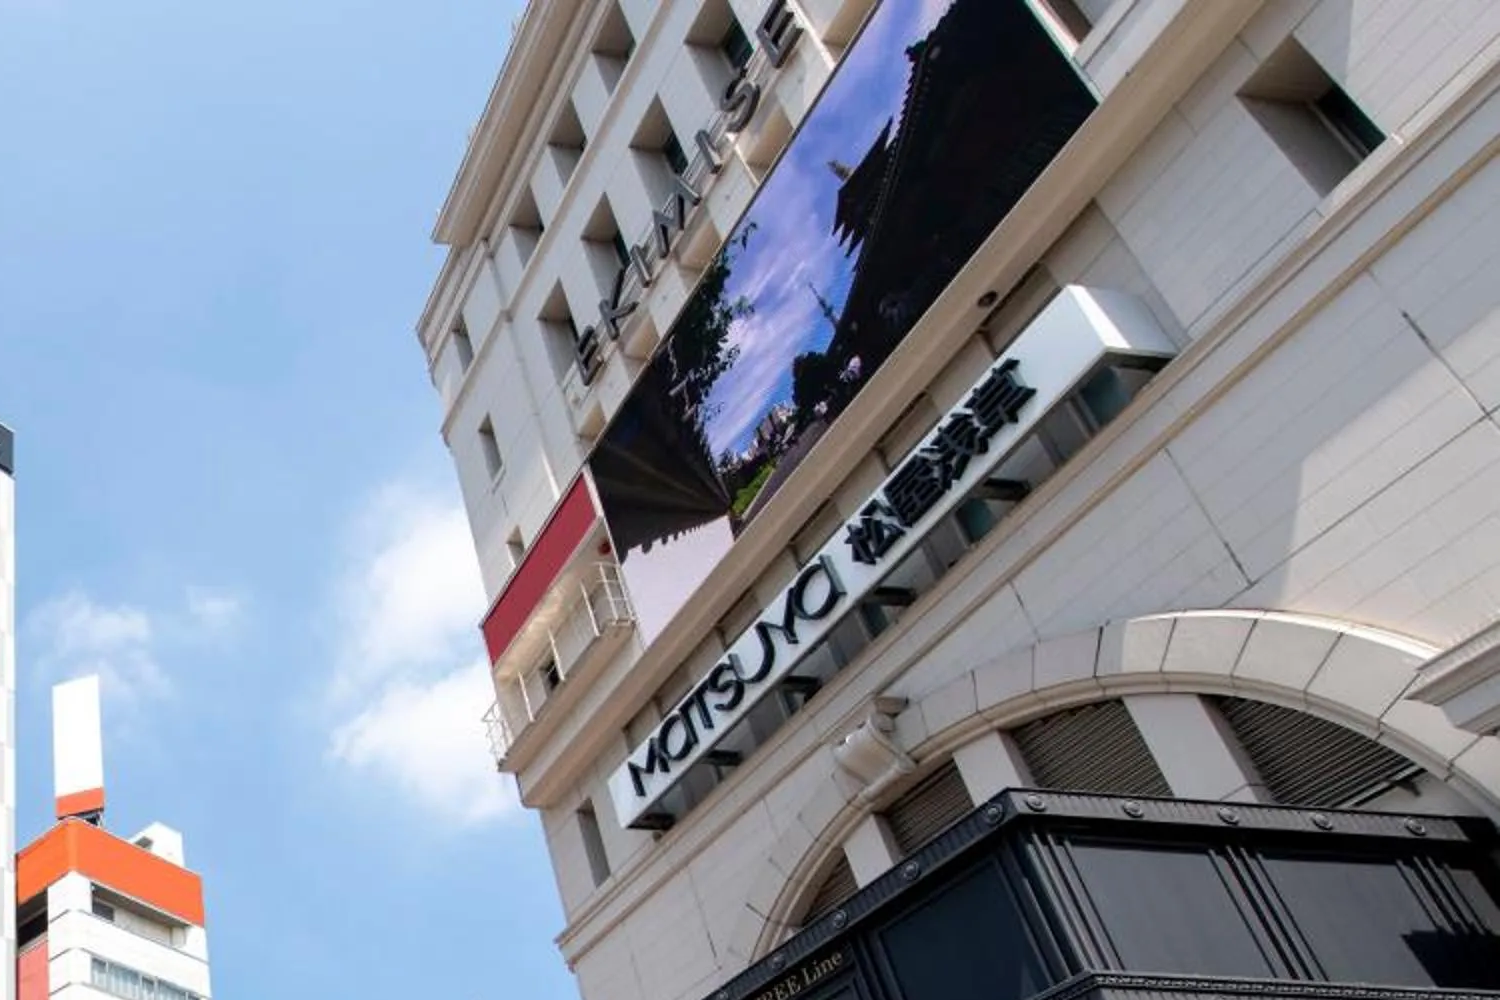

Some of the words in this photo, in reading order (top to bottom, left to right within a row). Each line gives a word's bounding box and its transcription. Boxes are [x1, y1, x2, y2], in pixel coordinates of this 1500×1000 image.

[573, 0, 804, 386] EKIMISE
[844, 358, 1038, 566] 松屋浅草
[802, 951, 844, 988] Line
